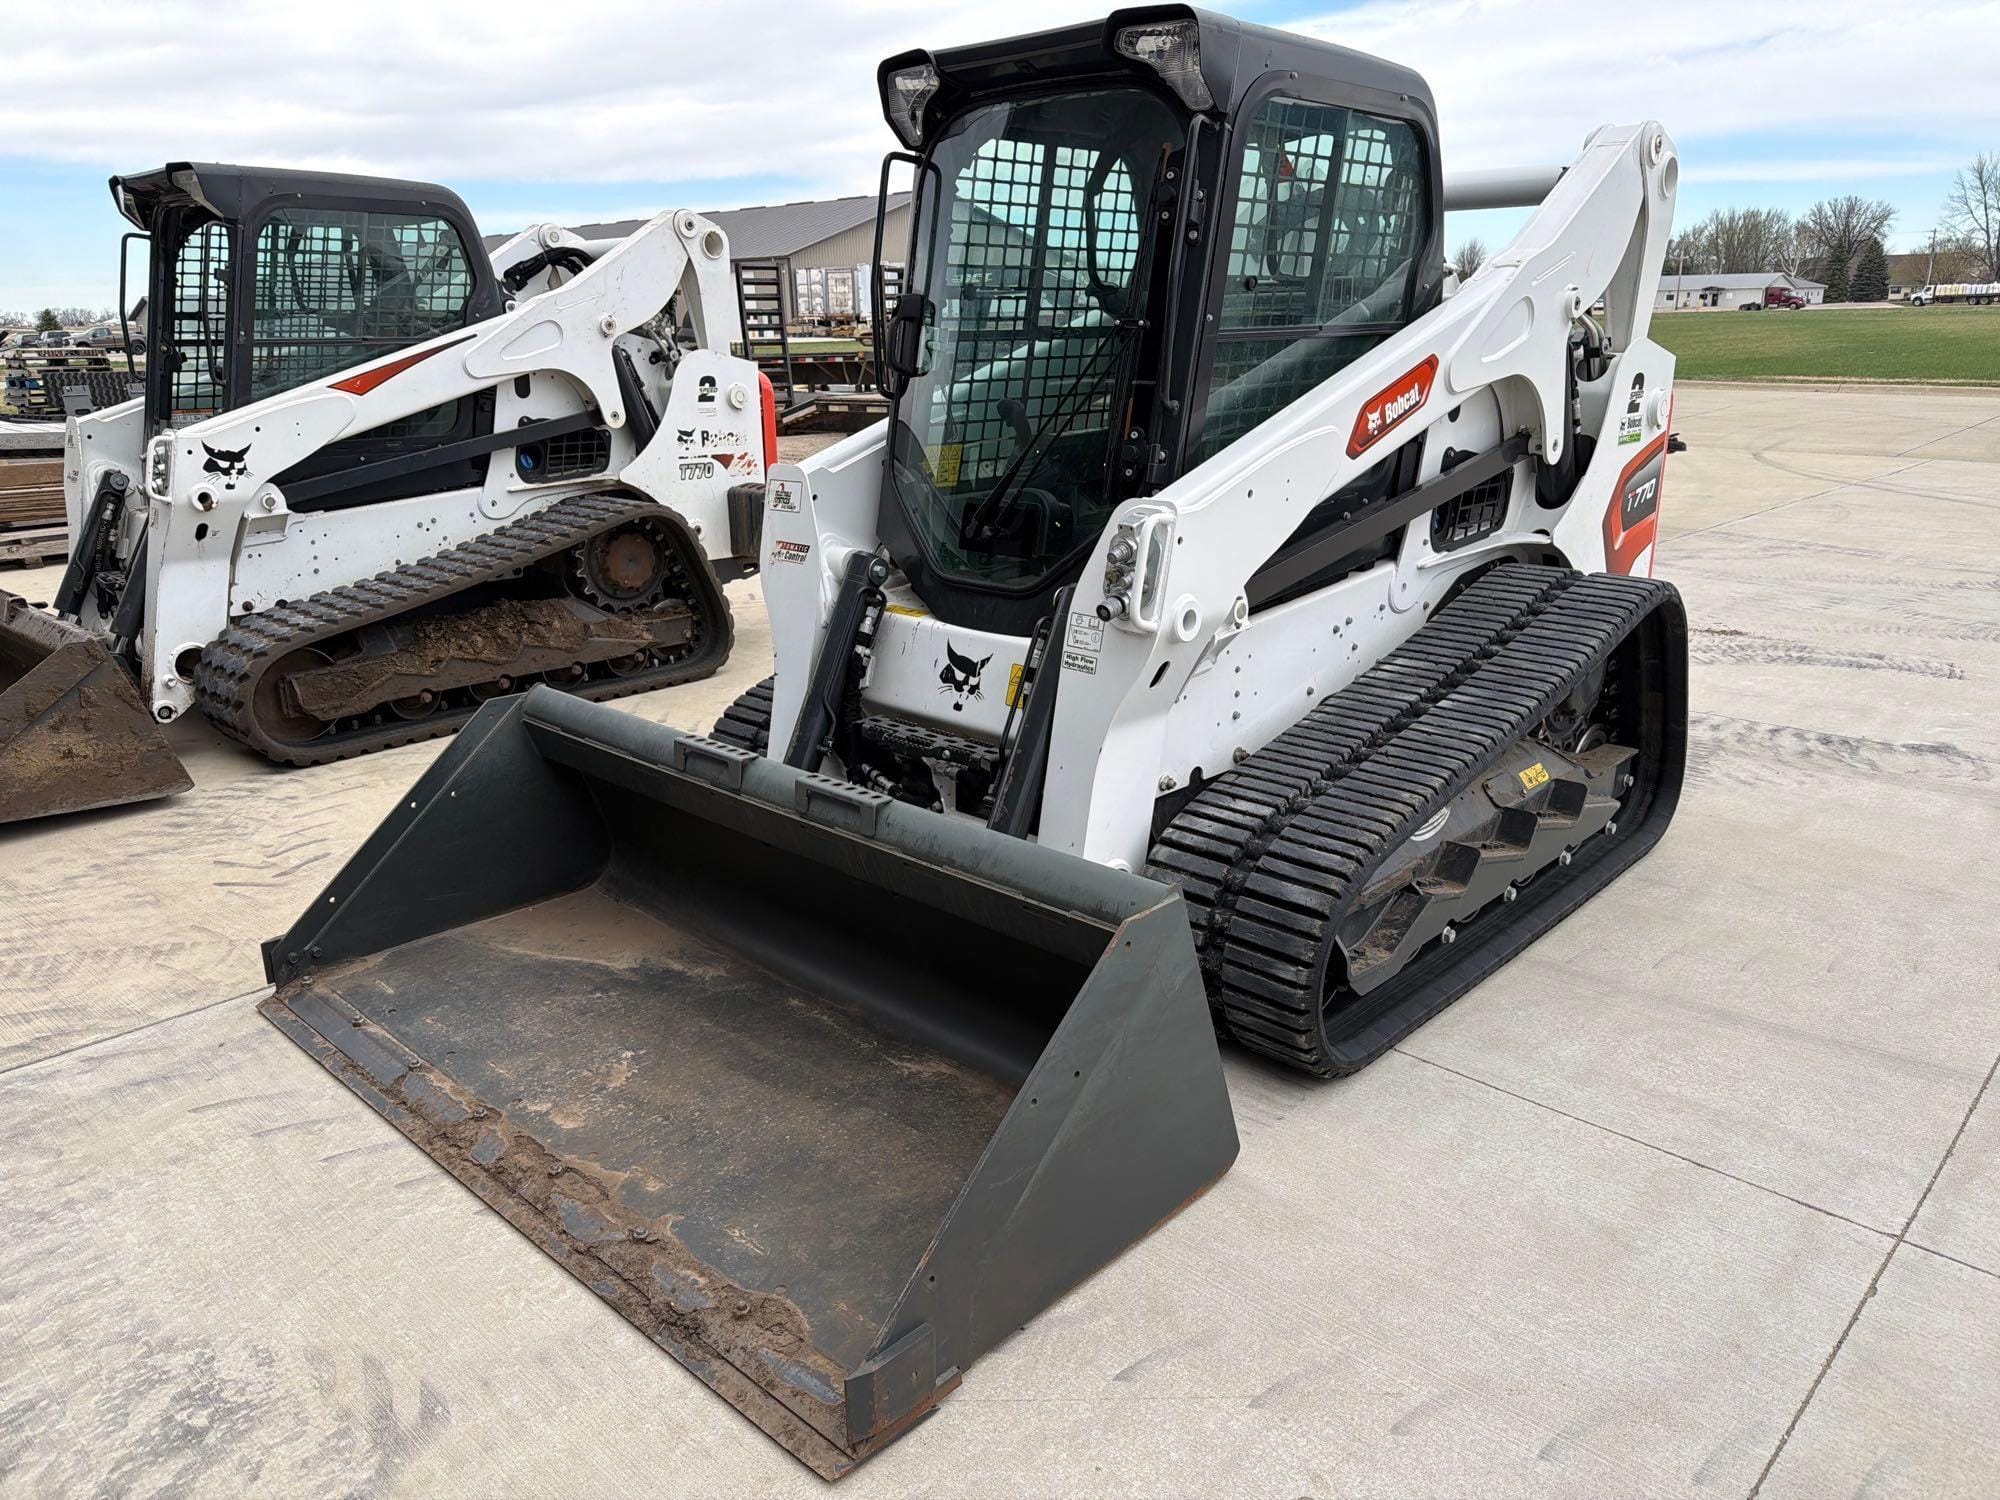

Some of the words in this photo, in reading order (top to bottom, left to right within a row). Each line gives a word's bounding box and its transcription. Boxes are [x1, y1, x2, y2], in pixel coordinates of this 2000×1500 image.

[698, 375, 717, 402] 2
[1627, 372, 1645, 414] 2
[1385, 382, 1420, 425] Bobcat
[679, 462, 715, 481] T770
[1627, 477, 1657, 513] T770
[784, 550, 807, 563] Control
[1064, 660, 1094, 671] Hydraulics
[1066, 653, 1079, 662] High
[1080, 655, 1094, 665] Flow
